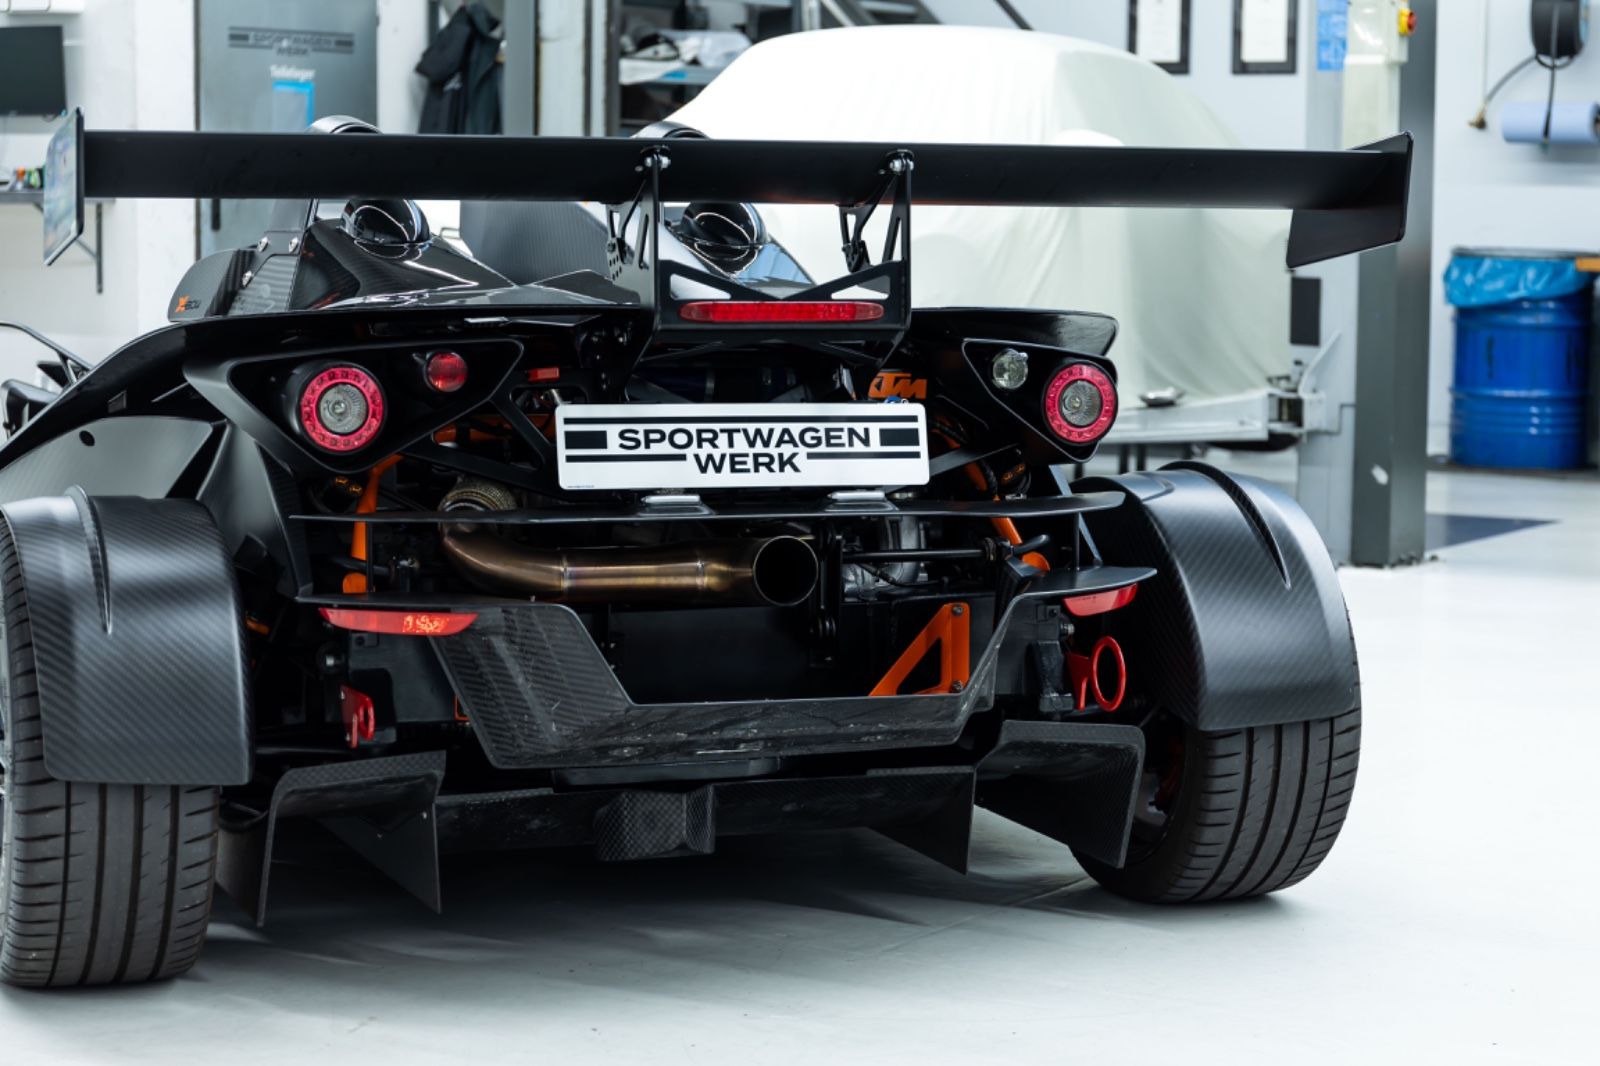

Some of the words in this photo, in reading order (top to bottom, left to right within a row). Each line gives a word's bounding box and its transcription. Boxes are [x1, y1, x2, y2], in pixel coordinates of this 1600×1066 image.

[868, 371, 927, 399] KTM
[617, 427, 871, 450] SPORTWAGEN
[693, 452, 802, 475] WERK
